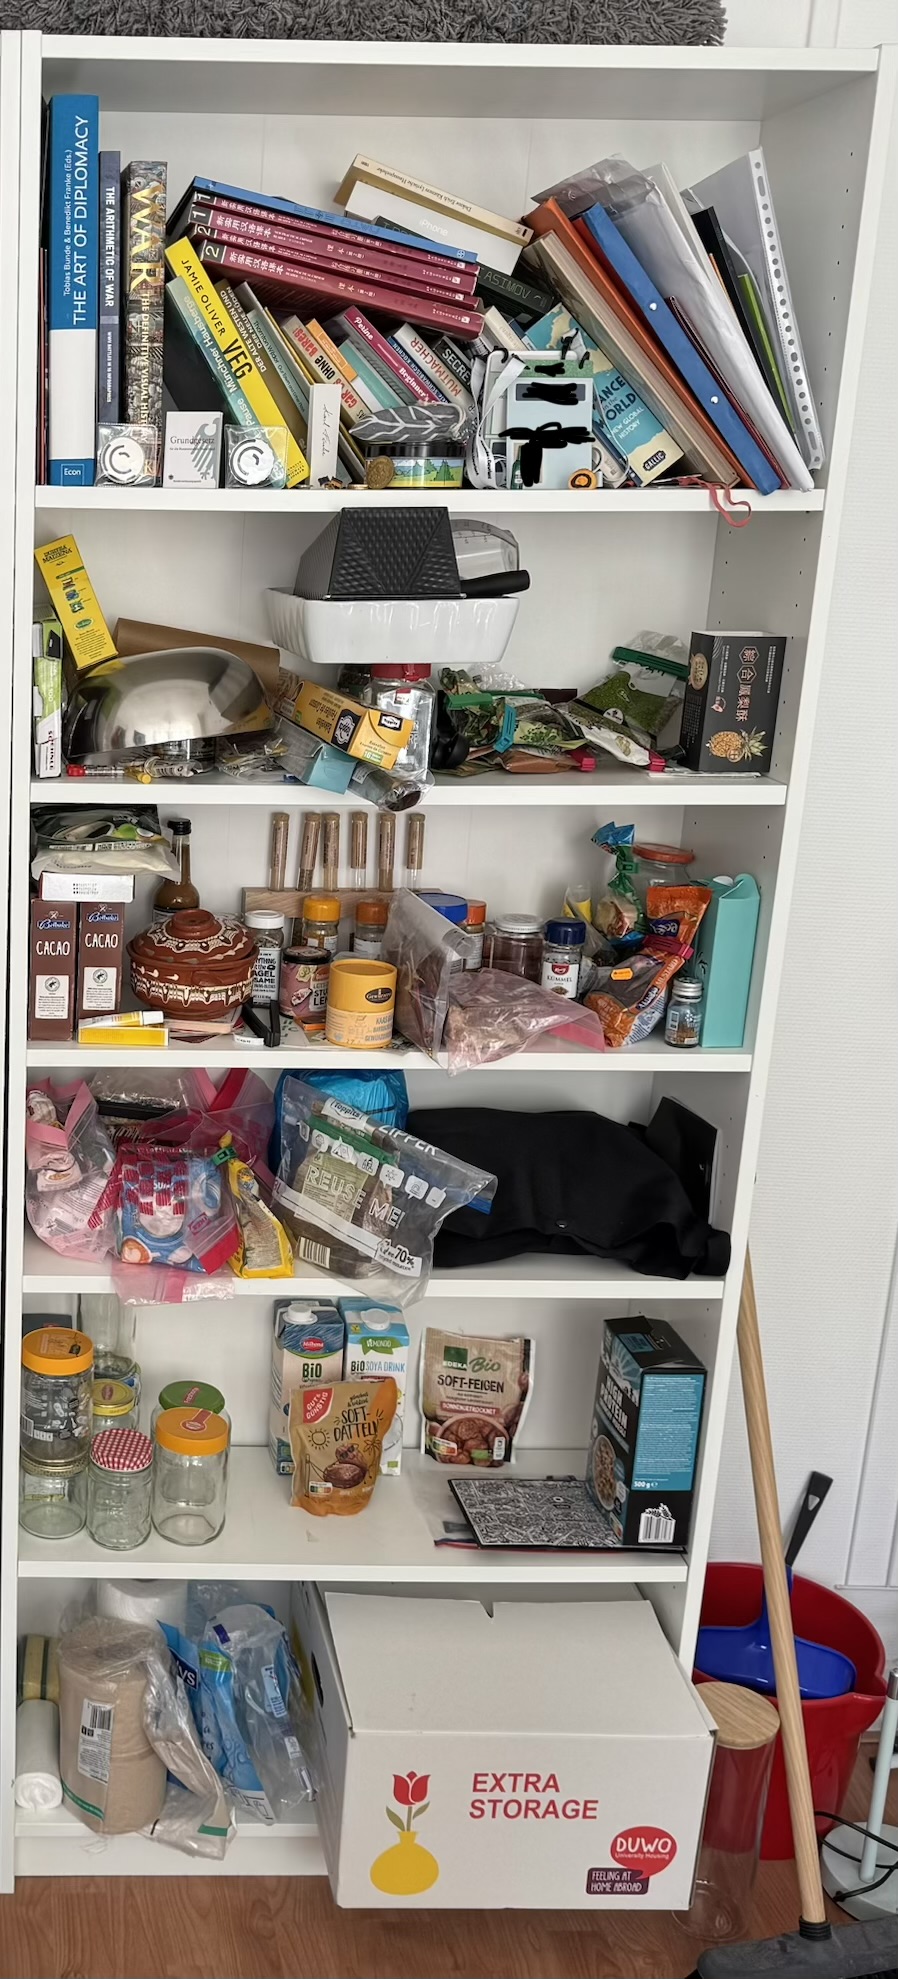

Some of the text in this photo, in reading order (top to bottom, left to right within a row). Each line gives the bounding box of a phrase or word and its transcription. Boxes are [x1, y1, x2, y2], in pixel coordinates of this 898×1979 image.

[64, 150, 72, 172] (Eds.)
[73, 116, 88, 325] THE ART OF DIPLOMACY
[105, 186, 116, 306] THE ARITHMETIC OF WAR
[130, 183, 166, 292] WAR
[182, 260, 226, 337] JAMIE OLIVER
[484, 269, 532, 299] ASIMOV
[140, 293, 150, 310] THE
[219, 289, 267, 372] DER ALTE WESTEN UND
[224, 285, 263, 348] DER NEUE SÜDEN
[140, 312, 150, 366] DEFINITIVE
[252, 319, 271, 346] Thornton
[266, 345, 280, 364] Wilder
[184, 296, 255, 426] Pause Münchner Hausberge
[222, 338, 252, 380] VEG
[410, 337, 462, 396] MUTMACHER
[140, 368, 149, 400] VISUAL
[396, 366, 431, 402] Beginner's
[609, 421, 624, 435] NEW
[620, 404, 646, 425] GLOBAL
[616, 418, 642, 439] HISTORY
[170, 436, 215, 446] Grundgesetz
[642, 450, 666, 470] GALLIC
[36, 940, 70, 956] CACAO
[85, 932, 119, 948] CACAO
[333, 1102, 362, 1120] Toppits
[306, 1166, 406, 1229] REUSE ME!
[366, 1363, 382, 1372] SOYA
[384, 1362, 406, 1372] DRINK
[443, 1357, 501, 1372] EDEKA Bio
[437, 1374, 505, 1393] SOFT-FEIGEN
[606, 1375, 623, 1408] HIGH
[306, 1391, 328, 1420] GÜNSTIG
[341, 1406, 370, 1424] SOFT-
[600, 1383, 628, 1430] PROTEIN
[334, 1420, 379, 1442] DATTELN
[472, 1772, 560, 1792] EXTRA
[469, 1799, 599, 1820] STORAGE
[616, 1836, 671, 1852] DUWO
[590, 1882, 642, 1891] HOME ABROAD
[592, 1870, 631, 1880] FEELING AT
